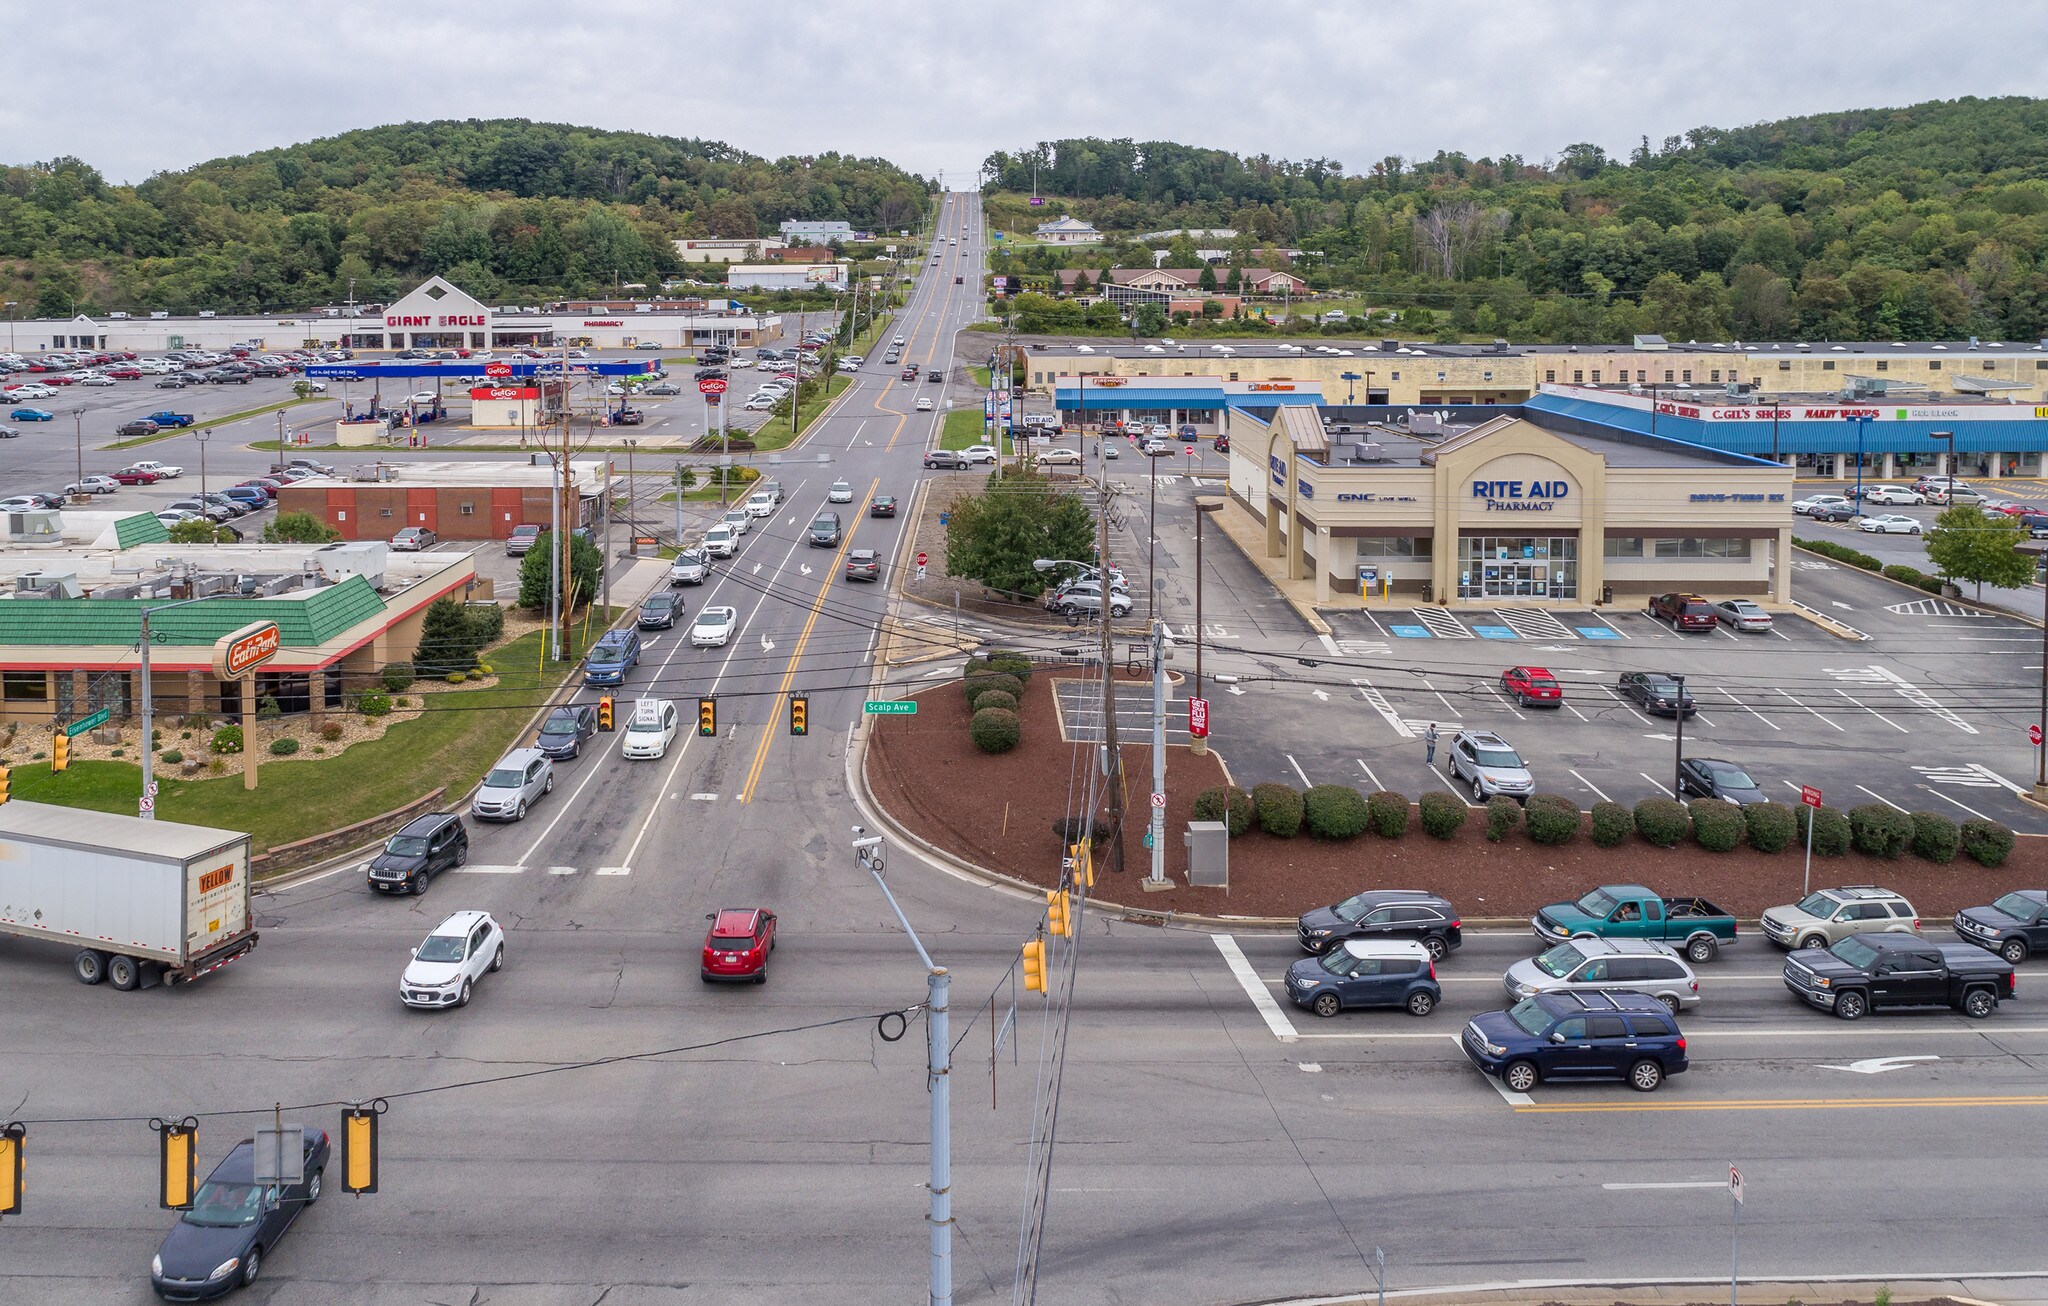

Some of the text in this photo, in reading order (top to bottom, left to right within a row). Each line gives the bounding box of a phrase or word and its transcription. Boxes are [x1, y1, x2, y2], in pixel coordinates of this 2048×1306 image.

[387, 315, 486, 326] GIANT EAGLE
[487, 367, 510, 375] GetGo
[700, 382, 724, 390] GetGo
[490, 389, 517, 397] GetGo
[1712, 409, 1791, 419] C.GIL'S SHOES
[1472, 480, 1569, 498] RITE AID
[1337, 493, 1376, 501] GNC
[868, 703, 909, 712] Scalp Ave
[1191, 700, 1206, 708] GET
[1191, 710, 1206, 719] FLU
[69, 712, 108, 735] Eisenhower Blvd
[2028, 729, 2042, 741] STOP
[1803, 787, 1820, 799] WRONG
[1806, 796, 1817, 804] WAY
[201, 867, 231, 891] YELLOW
